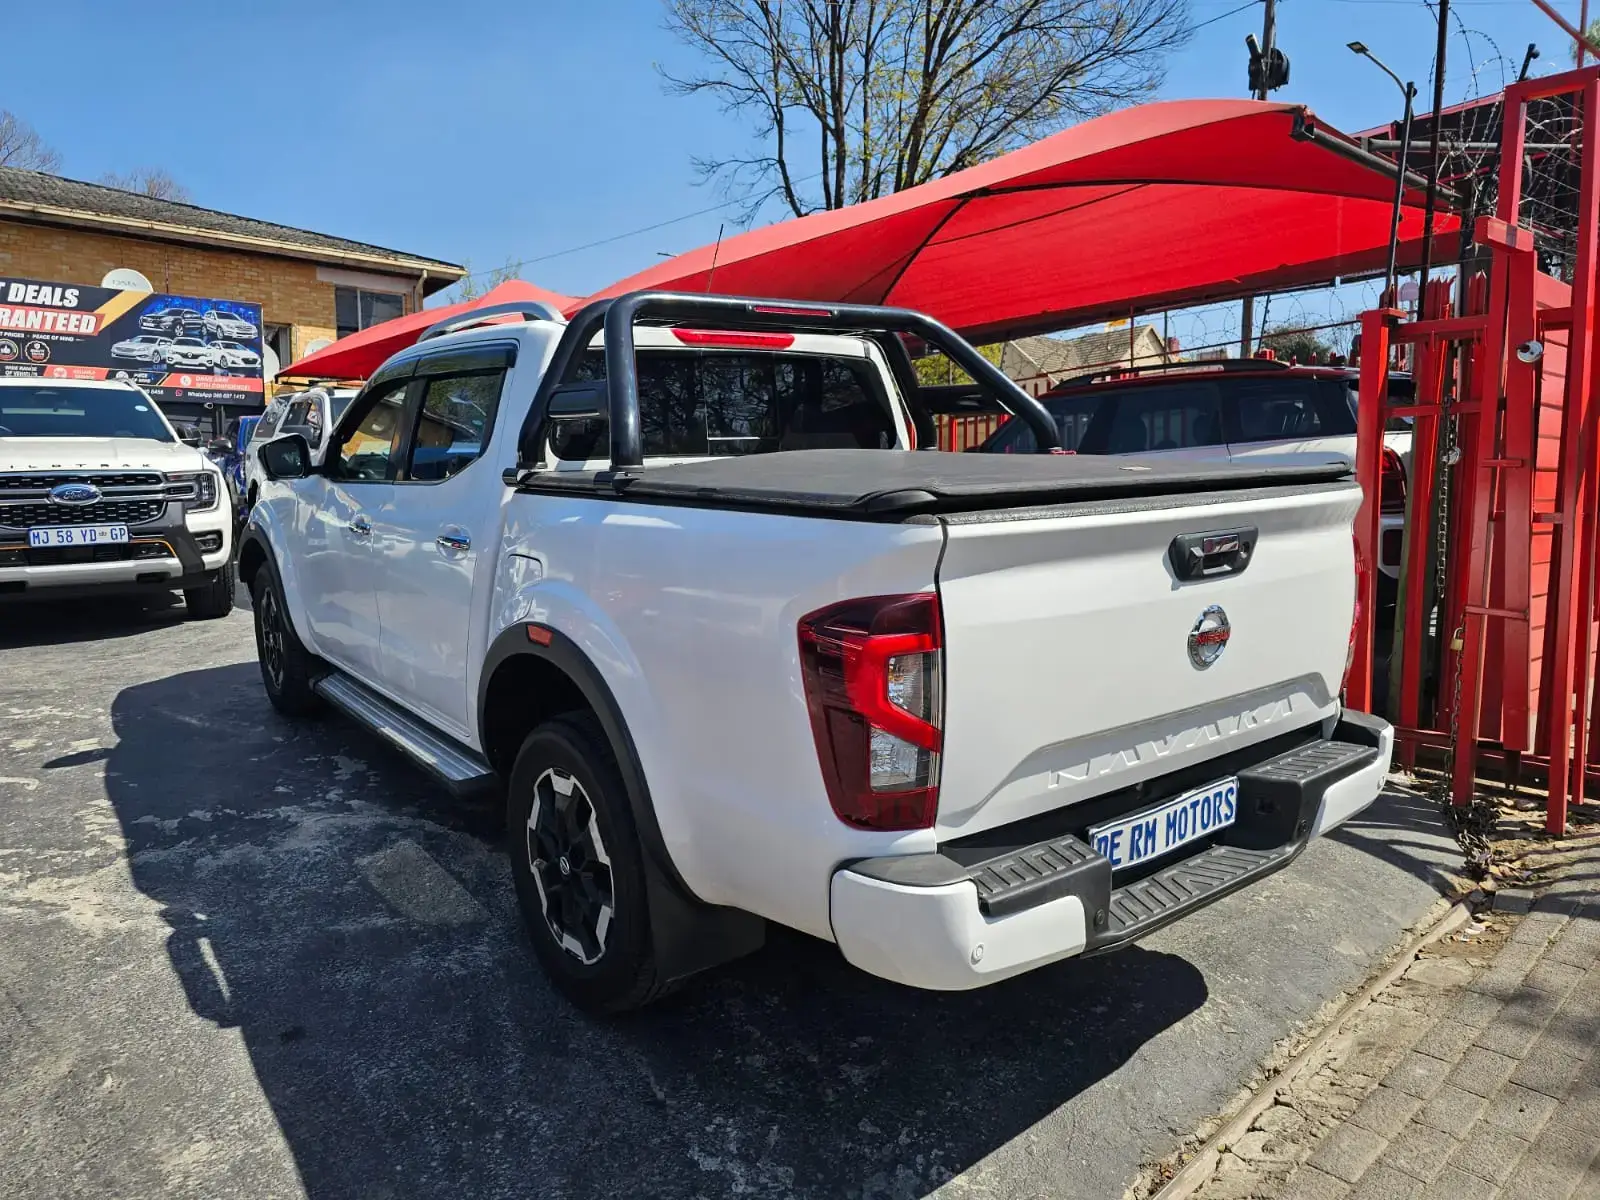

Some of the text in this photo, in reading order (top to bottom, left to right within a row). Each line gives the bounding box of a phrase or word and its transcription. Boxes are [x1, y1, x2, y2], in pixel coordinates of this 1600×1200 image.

[7, 282, 80, 308] DEALS
[32, 527, 126, 545] MJ 58 YD GP
[1047, 694, 1294, 789] NAVARA
[1128, 817, 1158, 861] RM
[1165, 786, 1235, 848] MOTORS
